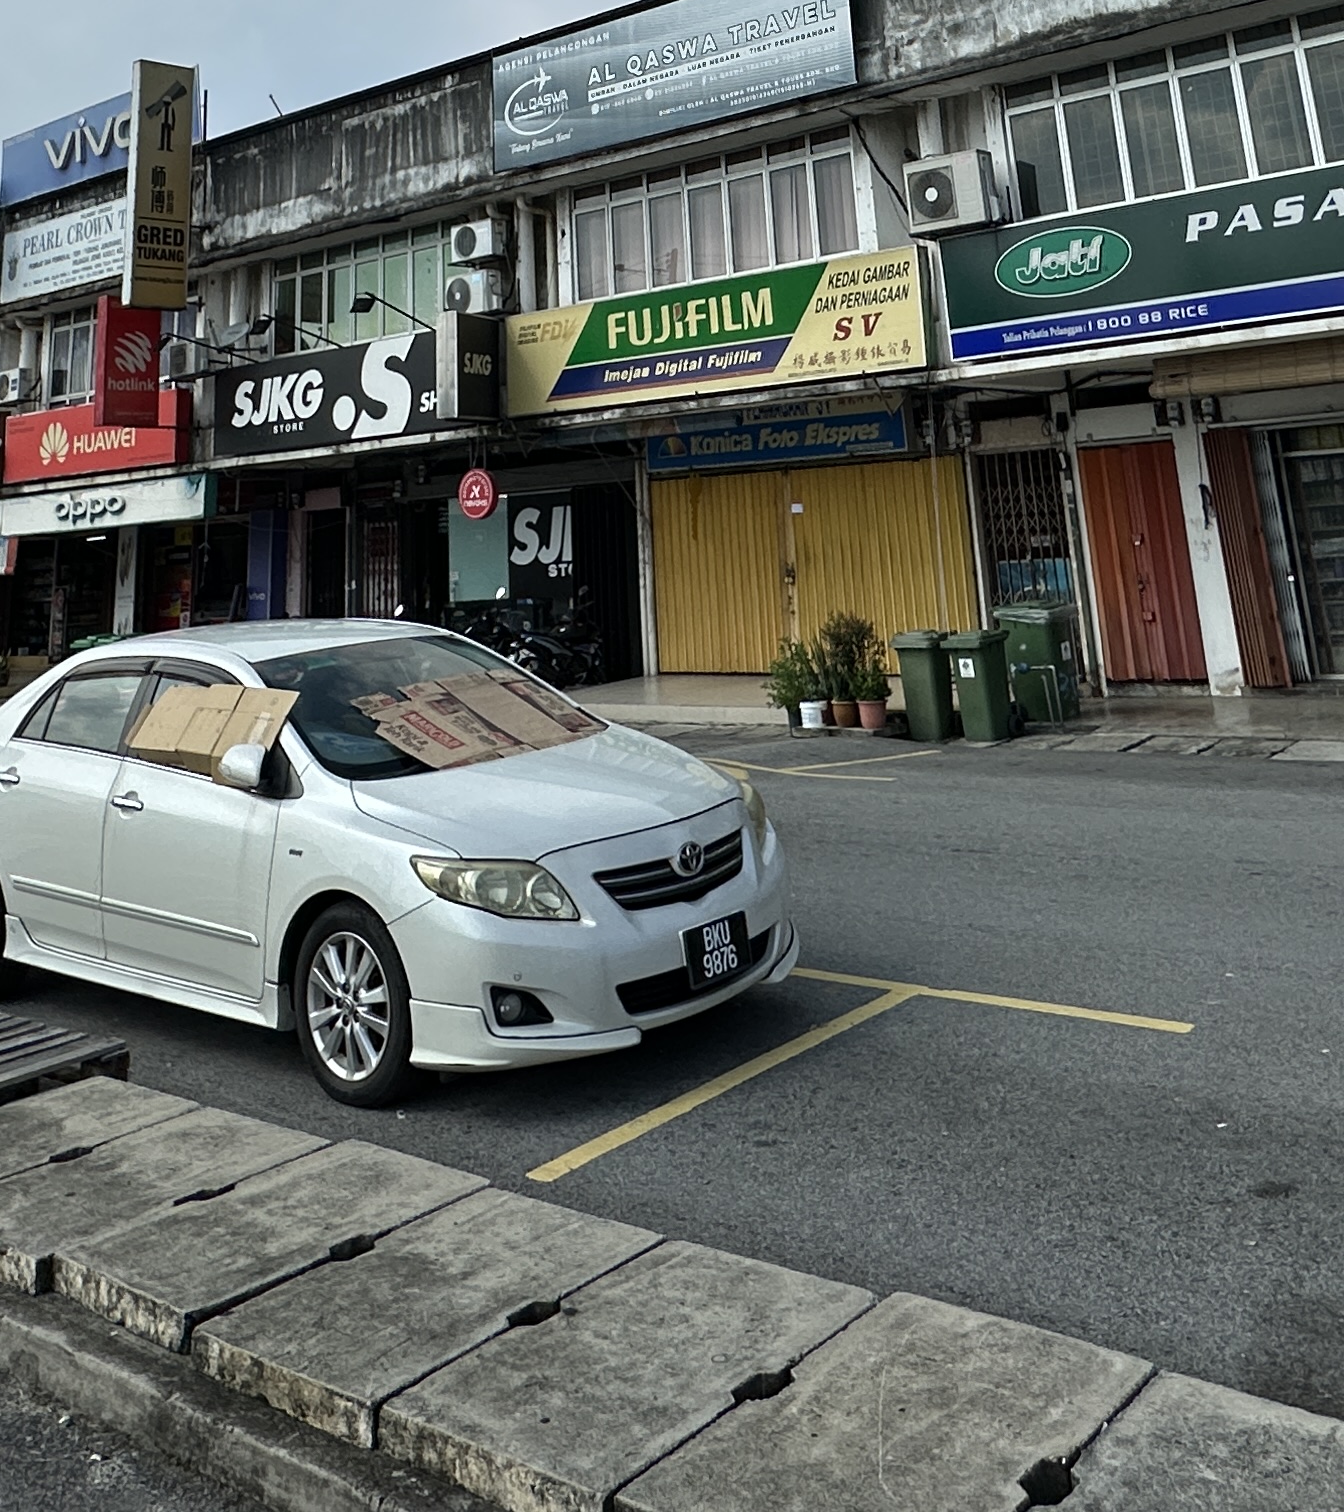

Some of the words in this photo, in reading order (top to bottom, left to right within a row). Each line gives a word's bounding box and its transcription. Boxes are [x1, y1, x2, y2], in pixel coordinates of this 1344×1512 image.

[498, 55, 533, 73] AGENSI
[536, 32, 610, 61] PELANCONGAN
[587, 62, 616, 86] AL
[626, 32, 718, 76] QASWA
[513, 102, 528, 115] AL
[528, 89, 569, 110] QASWA
[543, 100, 569, 115] TRAVEL
[22, 228, 63, 258] PEARL
[67, 212, 114, 245] CROWN
[137, 224, 185, 247] GRED
[136, 246, 184, 263] TUKANG
[1015, 234, 1104, 285] Jati
[827, 270, 860, 290] KEDAI
[862, 261, 910, 285] GAMBAR
[815, 295, 837, 314] DAN
[839, 283, 910, 310] PERNIAGAAN
[608, 287, 774, 349] FUJIFILM
[1002, 331, 1022, 344] Talian
[1023, 328, 1049, 342] Prihatin
[1096, 315, 1132, 331] 800
[1138, 311, 1162, 325] 88
[1169, 304, 1208, 320] RICE
[463, 352, 492, 376] SJKG
[655, 356, 703, 377] Digital
[706, 349, 762, 372] Fujifilm
[108, 376, 156, 392] hotlink
[231, 368, 324, 429] SJKG
[73, 427, 136, 455] HUAWEI
[273, 421, 304, 435] STORE
[689, 431, 752, 456] Konica
[758, 428, 799, 451] Foto
[804, 422, 881, 448] Ekspres
[55, 493, 126, 525] oppo
[510, 505, 573, 566] SJ
[404, 711, 460, 750] MARIGOLD
[702, 920, 731, 952] BKU
[703, 944, 738, 978] 9876
